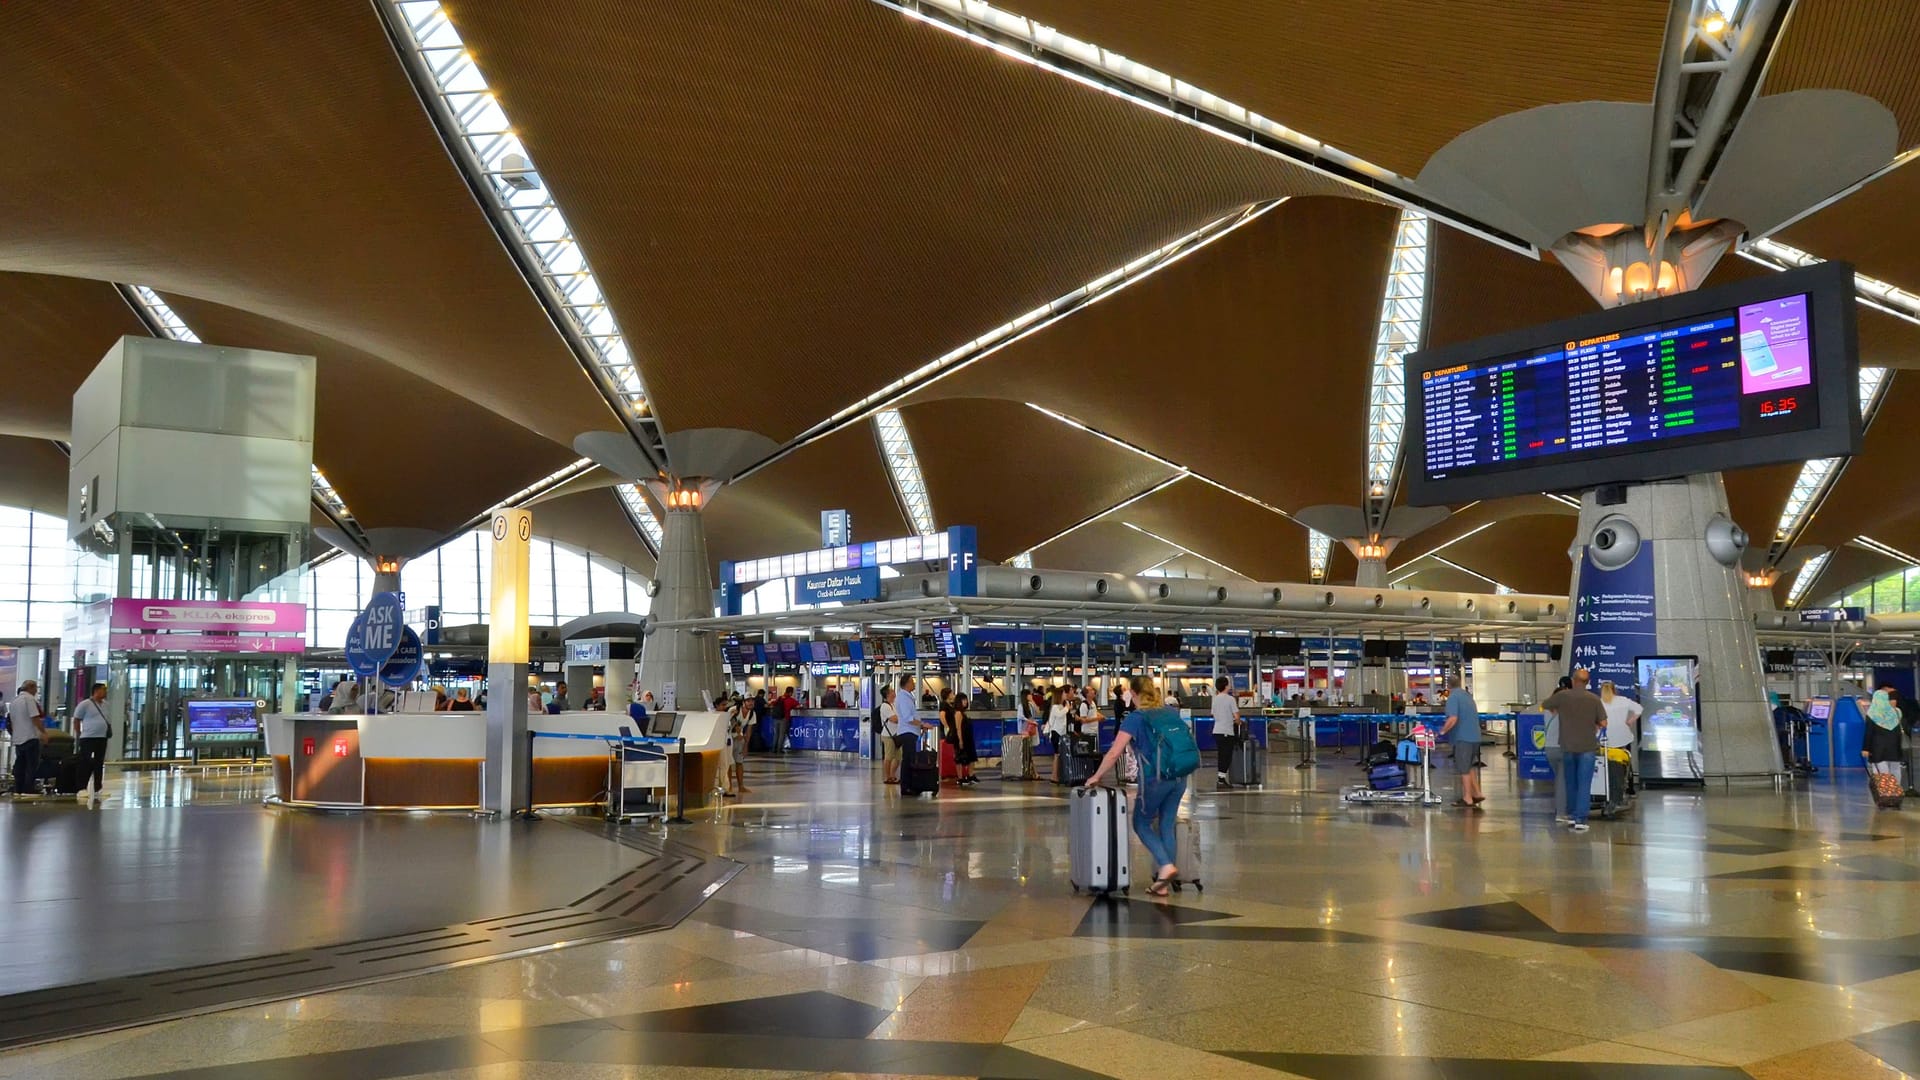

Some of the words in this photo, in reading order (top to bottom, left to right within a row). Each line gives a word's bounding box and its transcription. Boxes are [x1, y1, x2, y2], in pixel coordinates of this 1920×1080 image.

[1660, 330, 1678, 338] STATUS
[1690, 323, 1714, 332] REMARKS
[1580, 333, 1620, 347] DEPARTURES
[1526, 356, 1546, 365] REMARKS
[1434, 364, 1468, 376] DEPARTURES
[1761, 397, 1796, 413] 16:35
[828, 514, 840, 528] E
[830, 530, 840, 544] F
[951, 554, 958, 570] F
[964, 553, 974, 570] F
[721, 582, 726, 596] E
[807, 580, 826, 590] Kaunter
[827, 578, 844, 588] Daftar
[844, 574, 862, 586] Masuk
[834, 588, 850, 596] Counters
[183, 609, 222, 619] KLIA
[224, 610, 271, 621] ekspres
[368, 606, 393, 624] ASK
[429, 620, 438, 630] D
[140, 636, 146, 648] 1
[270, 638, 276, 650] 1
[365, 624, 392, 650] ME
[956, 634, 962, 654] F
[790, 727, 810, 738] COME
[814, 728, 824, 738] TO
